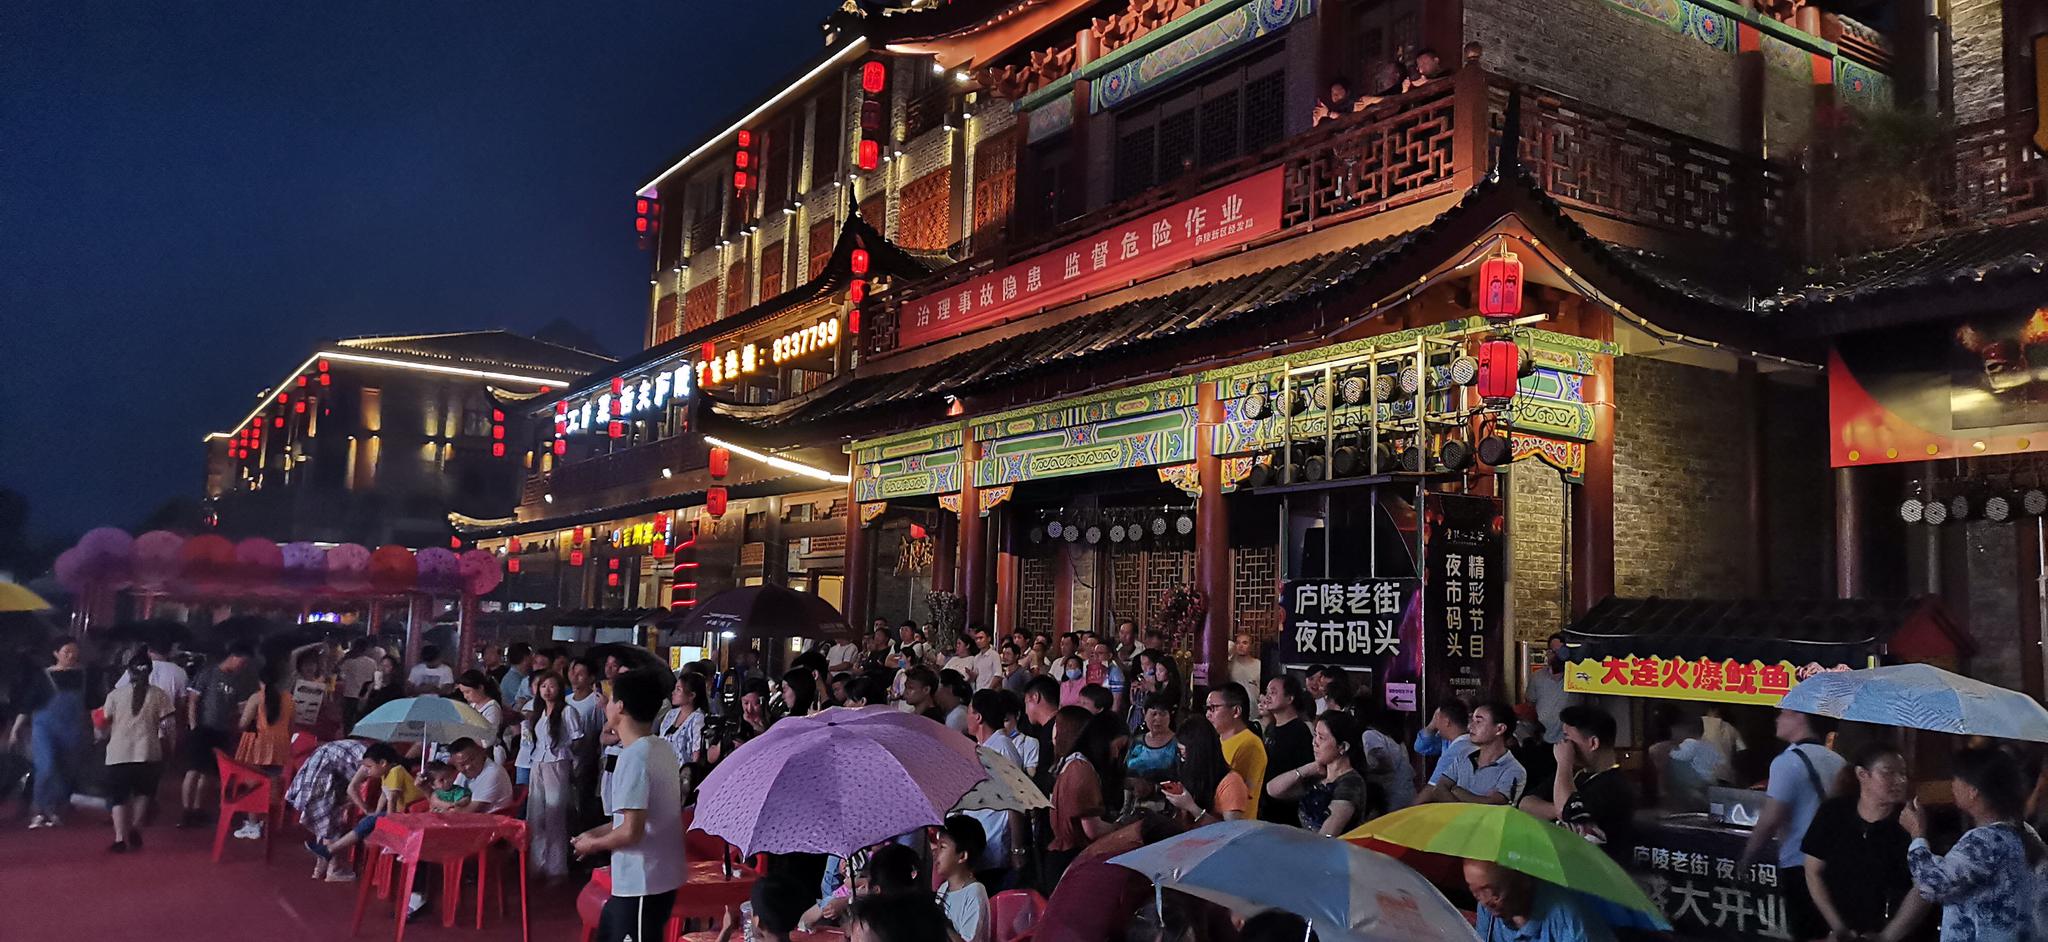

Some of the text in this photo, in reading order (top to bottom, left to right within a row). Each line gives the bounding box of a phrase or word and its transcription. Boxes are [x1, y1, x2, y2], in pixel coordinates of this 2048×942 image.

[917, 194, 1244, 327] 治理事故隐患 监督危险作业
[1295, 583, 1400, 615] 庐陵老街
[1445, 553, 1463, 658] 夜市码头
[1468, 554, 1485, 659] 精彩节目
[1295, 620, 1400, 657] 夜市码头
[1600, 657, 1791, 696] 大连火爆鱿鱼
